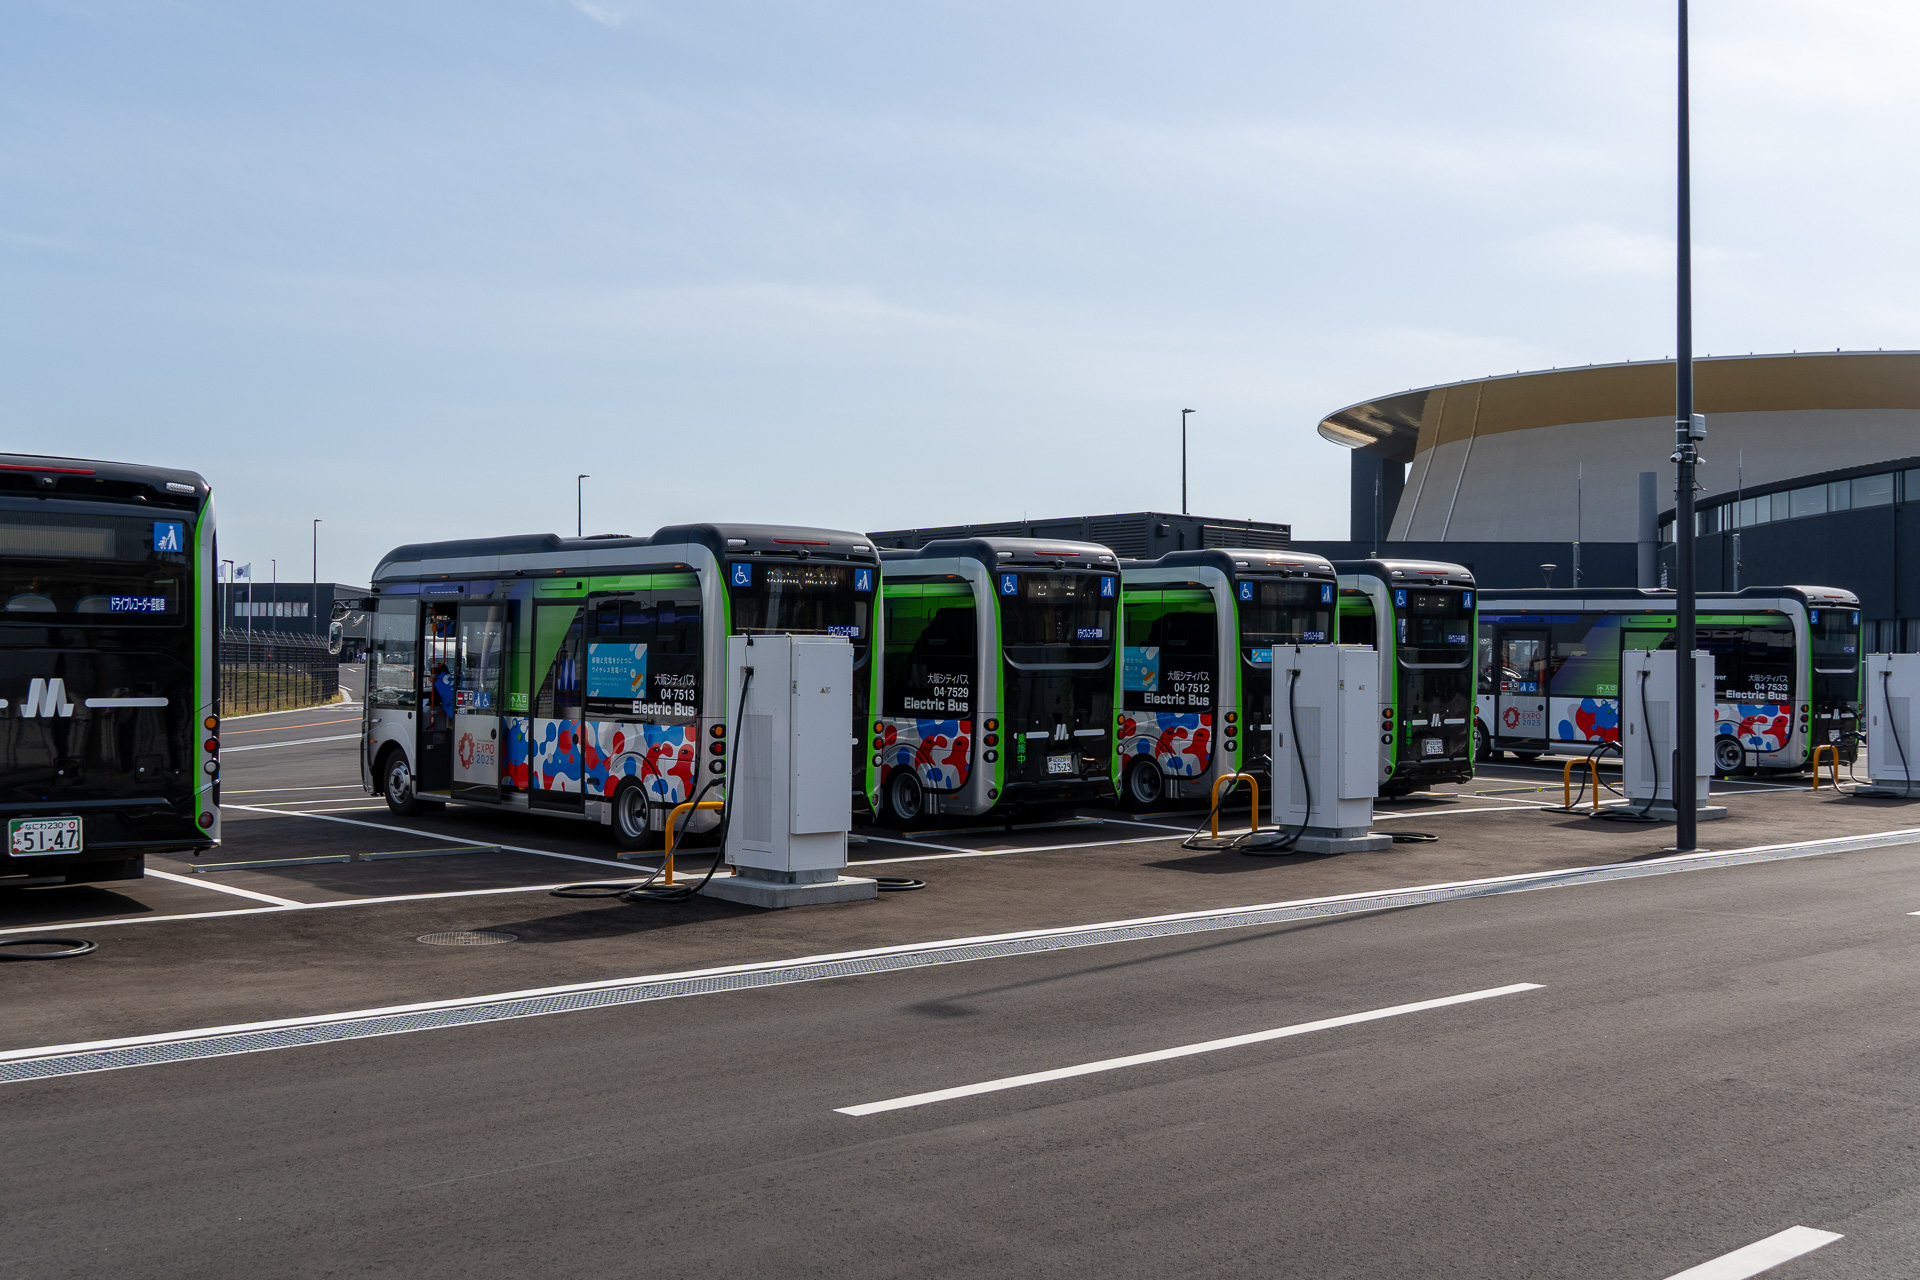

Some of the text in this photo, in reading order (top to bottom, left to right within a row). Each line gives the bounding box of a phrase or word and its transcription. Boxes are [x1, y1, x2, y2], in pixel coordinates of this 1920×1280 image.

[654, 673, 696, 686] 大阪シティバス
[927, 673, 969, 684] 大阪シティバス
[1167, 671, 1210, 681] 大阪シティバス
[1748, 674, 1788, 682] 大阪シティバス
[933, 686, 969, 698] 04-7529
[1174, 683, 1210, 693] 04-7512
[1754, 683, 1788, 691] 04-7533
[660, 688, 695, 701] 04-7513
[1143, 693, 1210, 706] Electric Bus
[1725, 689, 1788, 700] Electric Bus
[632, 700, 695, 717] Electric Bus
[904, 697, 969, 712] Electric Bus
[1521, 712, 1541, 720] EXPO
[476, 743, 495, 754] EXPO
[476, 754, 495, 765] 2025
[24, 829, 76, 850] 51-47
